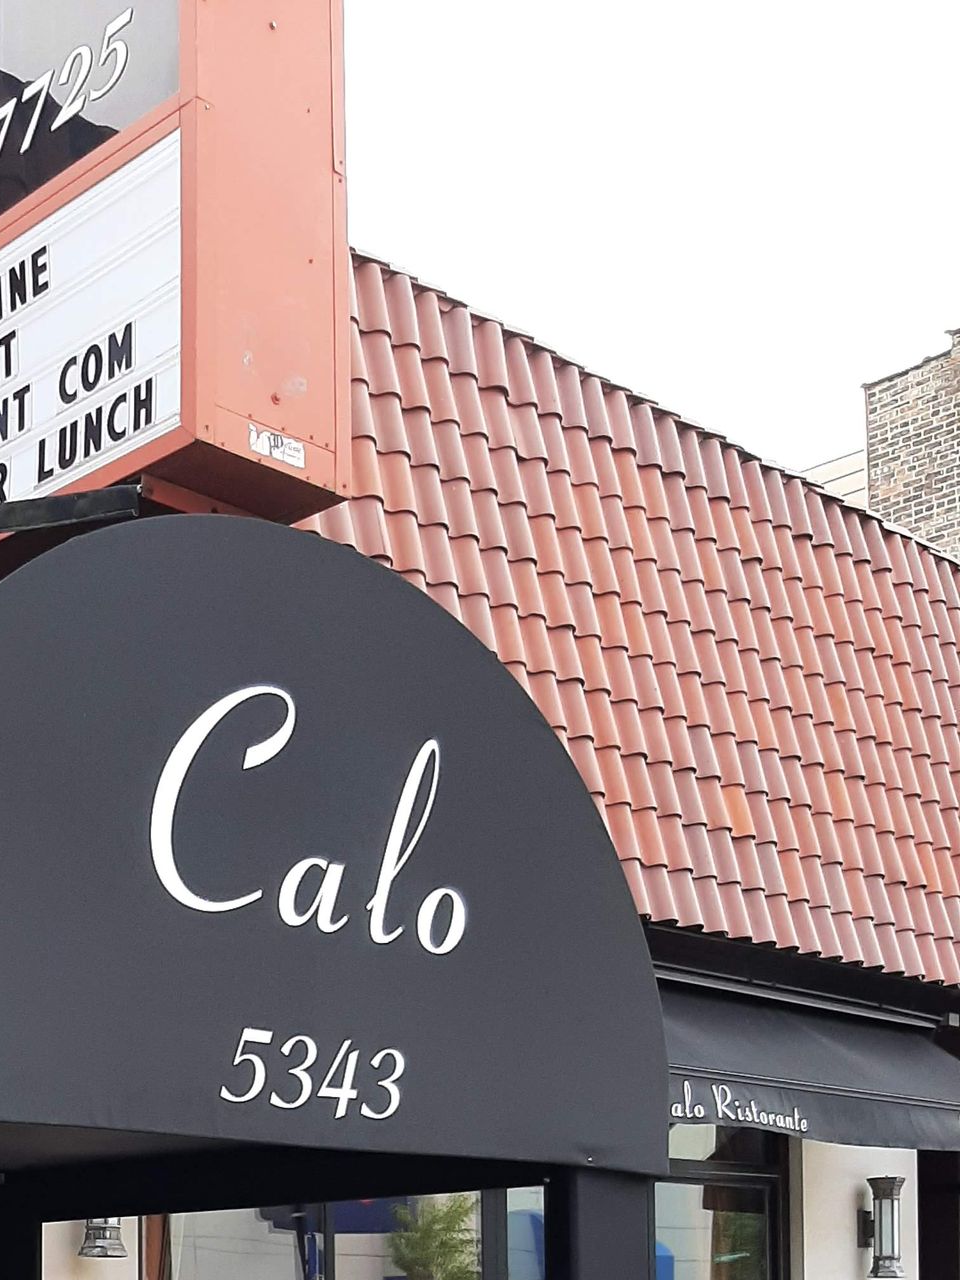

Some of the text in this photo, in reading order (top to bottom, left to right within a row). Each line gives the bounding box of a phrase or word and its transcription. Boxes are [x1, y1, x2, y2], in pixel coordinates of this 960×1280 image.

[58, 321, 133, 405] COM
[37, 377, 154, 484] LUNCH
[149, 684, 467, 956] Calo
[219, 1026, 406, 1120] 5343
[670, 1079, 809, 1132] alo Ristorante
